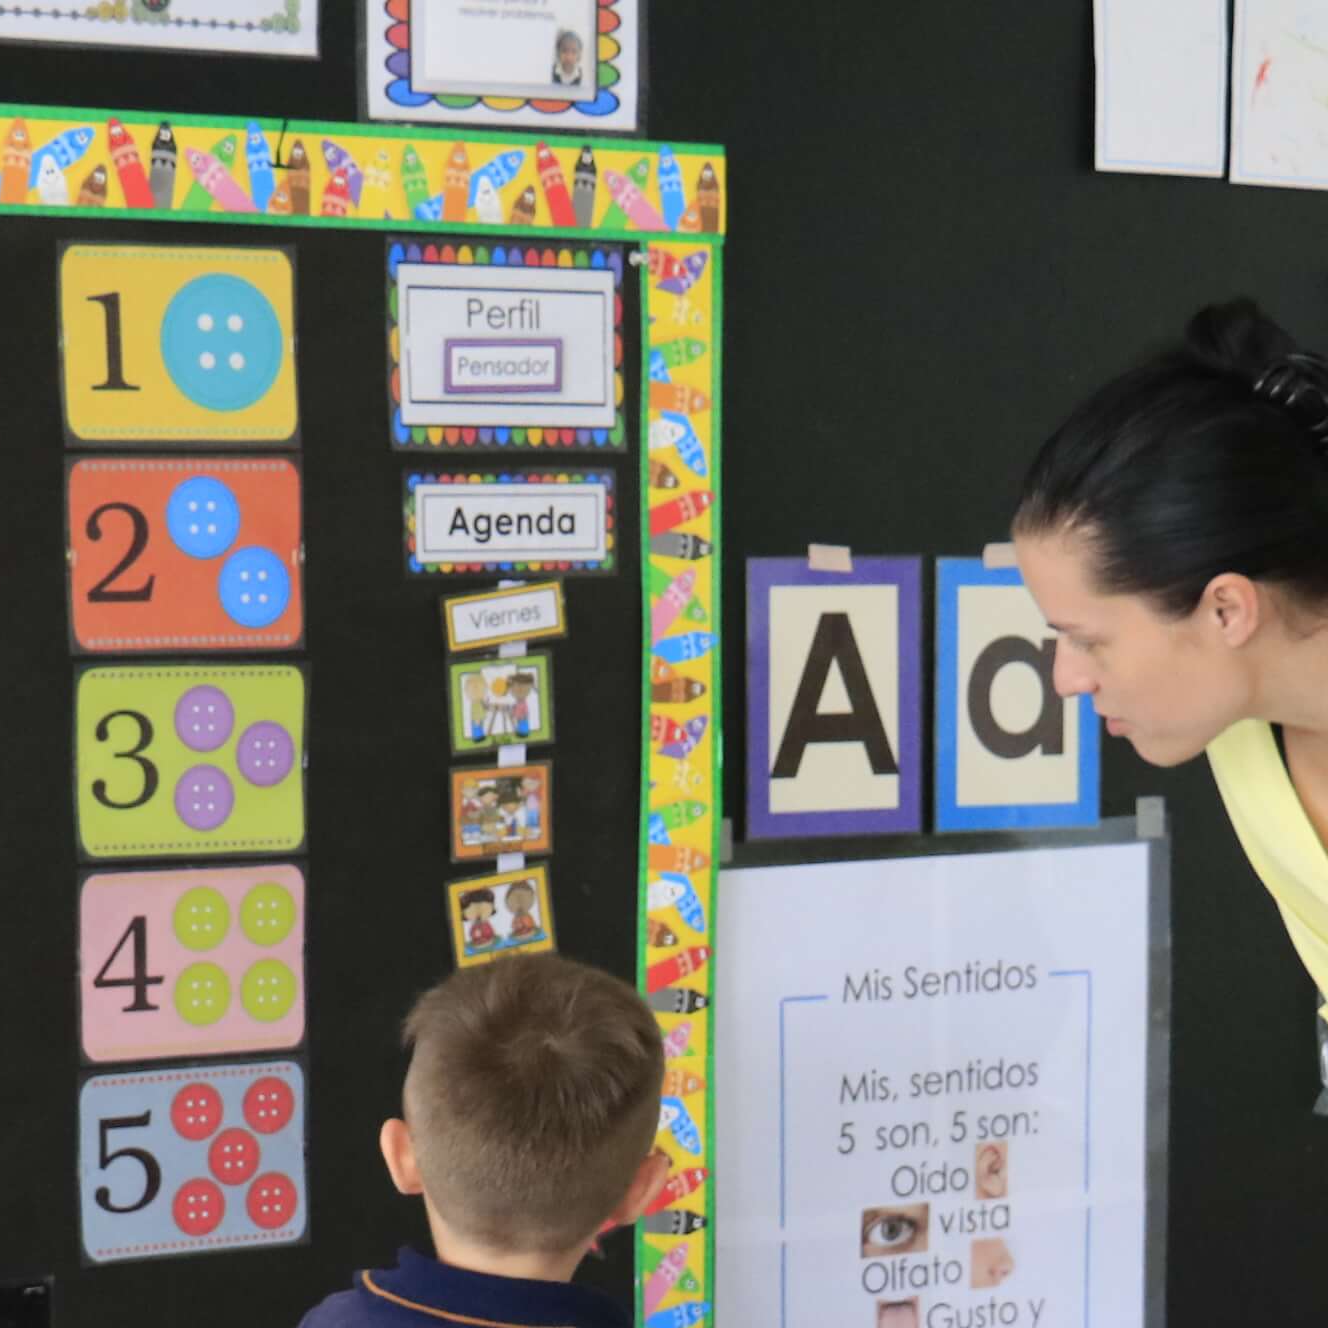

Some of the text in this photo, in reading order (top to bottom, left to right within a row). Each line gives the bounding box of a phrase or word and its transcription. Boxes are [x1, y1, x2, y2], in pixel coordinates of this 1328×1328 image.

[466, 298, 541, 330] Perfil
[85, 291, 142, 392] 1
[456, 354, 551, 377] Pensador
[447, 505, 577, 543] Agenda
[85, 501, 157, 603] 2
[468, 603, 541, 630] Viernes
[769, 612, 900, 779] A
[966, 634, 1066, 760] a
[91, 709, 160, 810] 3
[92, 915, 165, 1014] 4
[841, 959, 1039, 1004] Mis Sentidos
[838, 1057, 1040, 1105] Mis, sentidos
[836, 1109, 1040, 1155] 5 son, 5 son:
[93, 1108, 163, 1214] 5
[890, 1160, 970, 1198] Oído
[938, 1203, 1011, 1235] vista
[861, 1254, 963, 1294] Olfato
[1027, 1297, 1046, 1328] y
